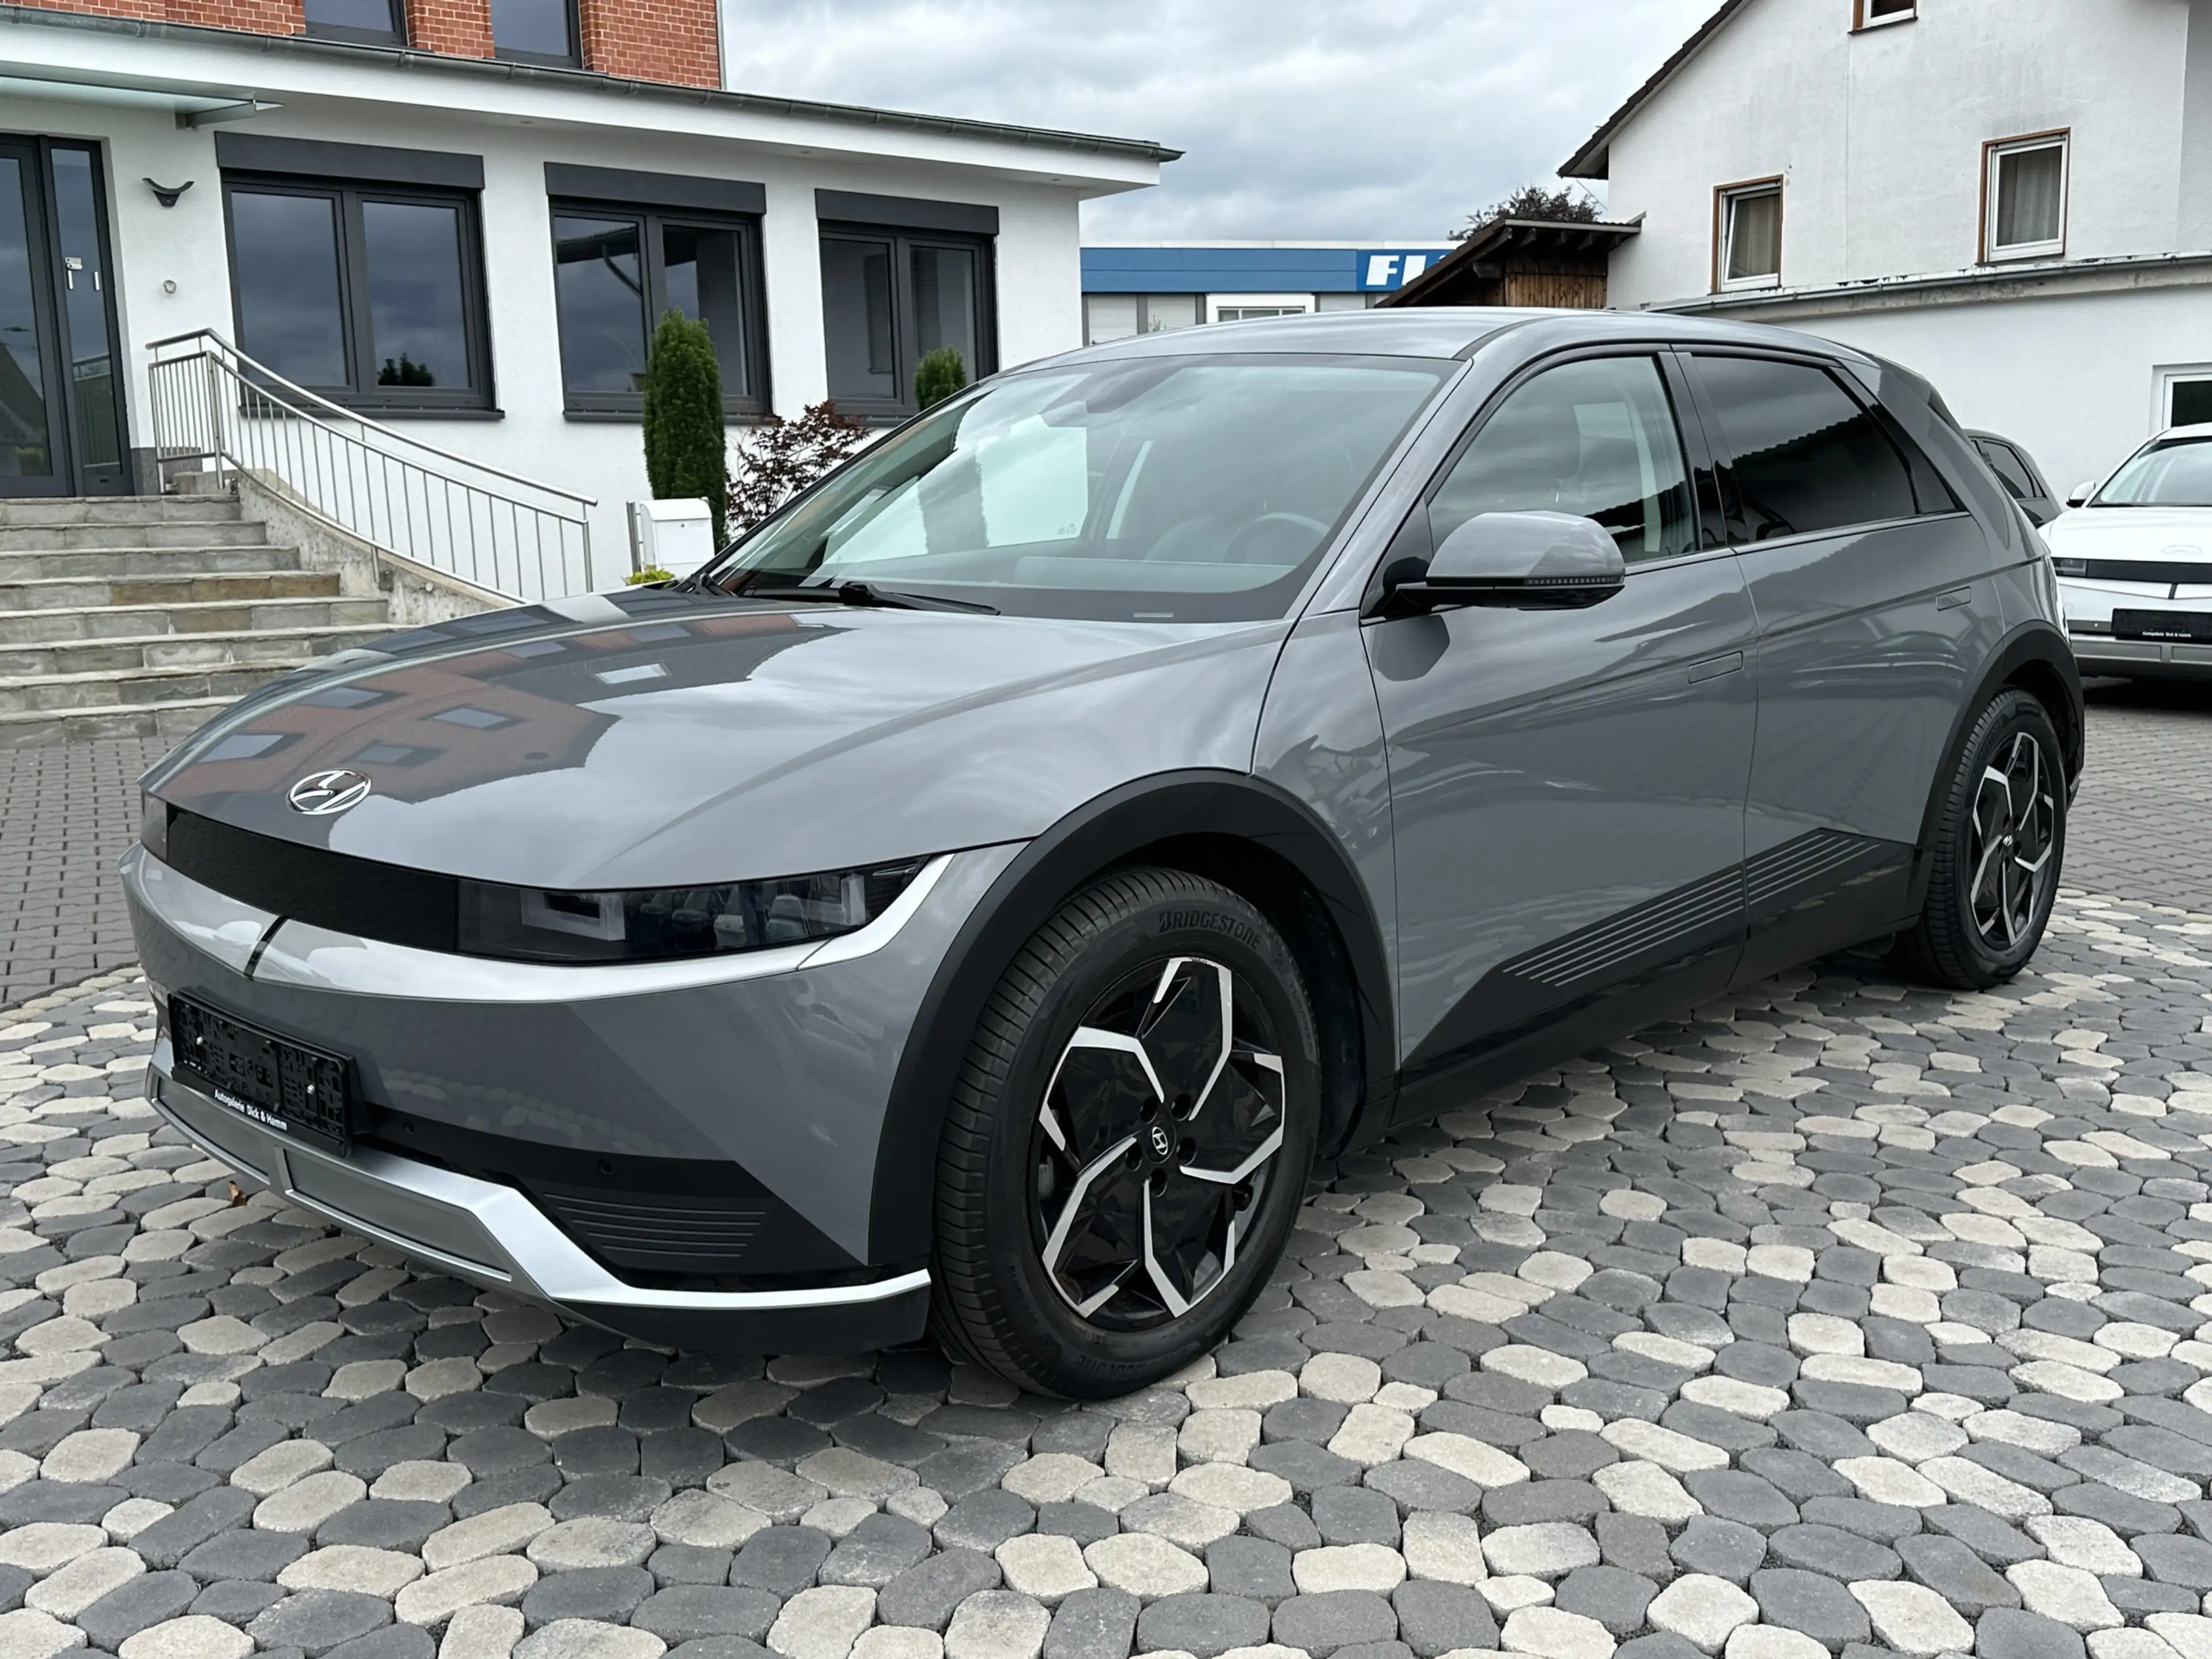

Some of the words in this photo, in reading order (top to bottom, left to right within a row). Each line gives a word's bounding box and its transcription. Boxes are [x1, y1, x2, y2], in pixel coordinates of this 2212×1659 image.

[1366, 255, 1446, 286] FI
[1158, 910, 1262, 950] BRIDGESTONE
[214, 1089, 245, 1113] Autogalerie
[247, 1104, 260, 1120] Dick
[260, 1111, 266, 1122] &
[266, 1113, 287, 1131] Hamm
